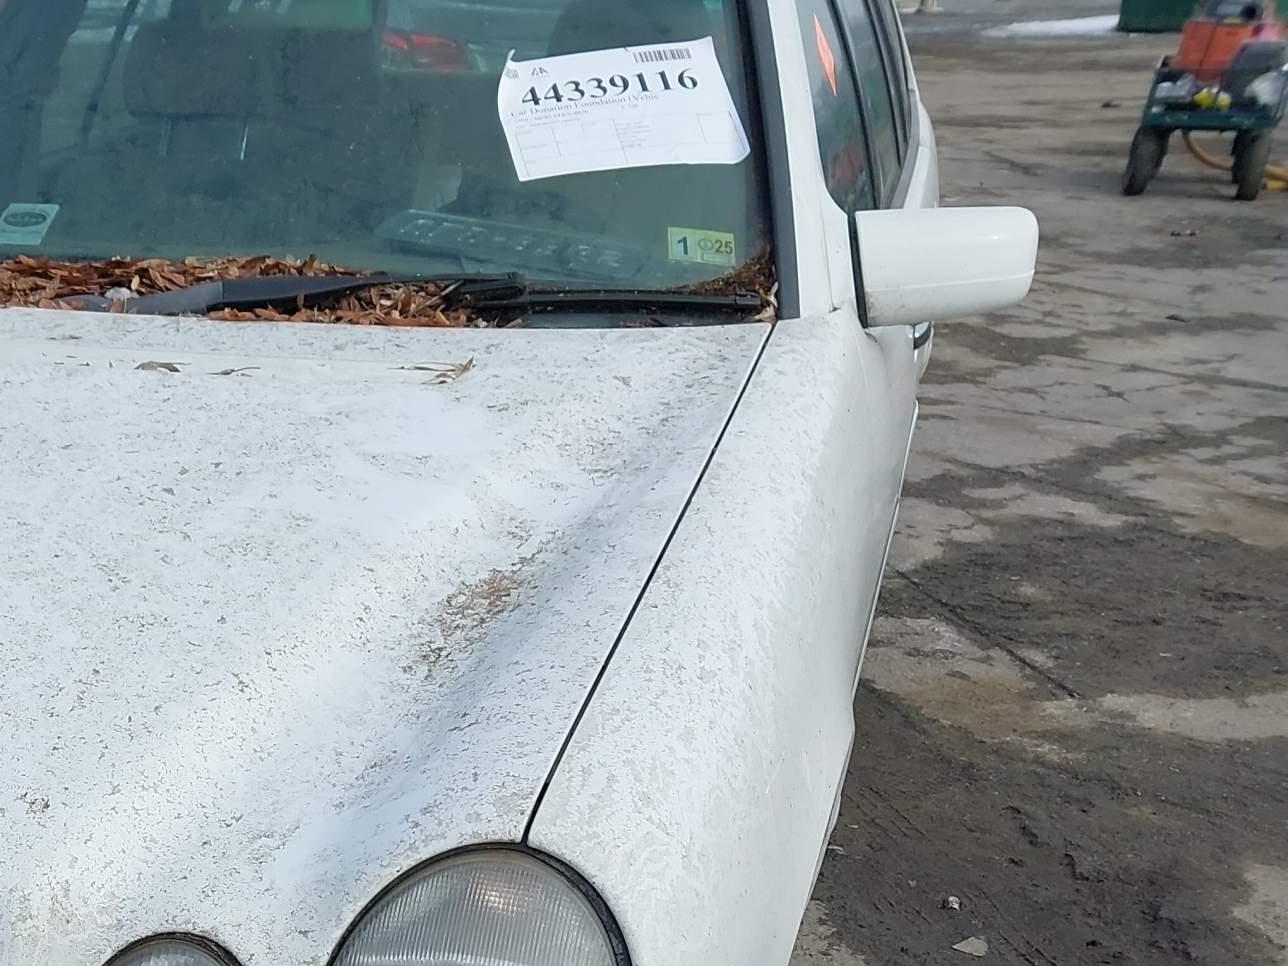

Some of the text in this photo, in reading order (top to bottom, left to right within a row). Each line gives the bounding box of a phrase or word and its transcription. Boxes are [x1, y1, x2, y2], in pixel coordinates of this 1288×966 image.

[521, 67, 698, 107] 44339116
[677, 236, 733, 255] 1 25
